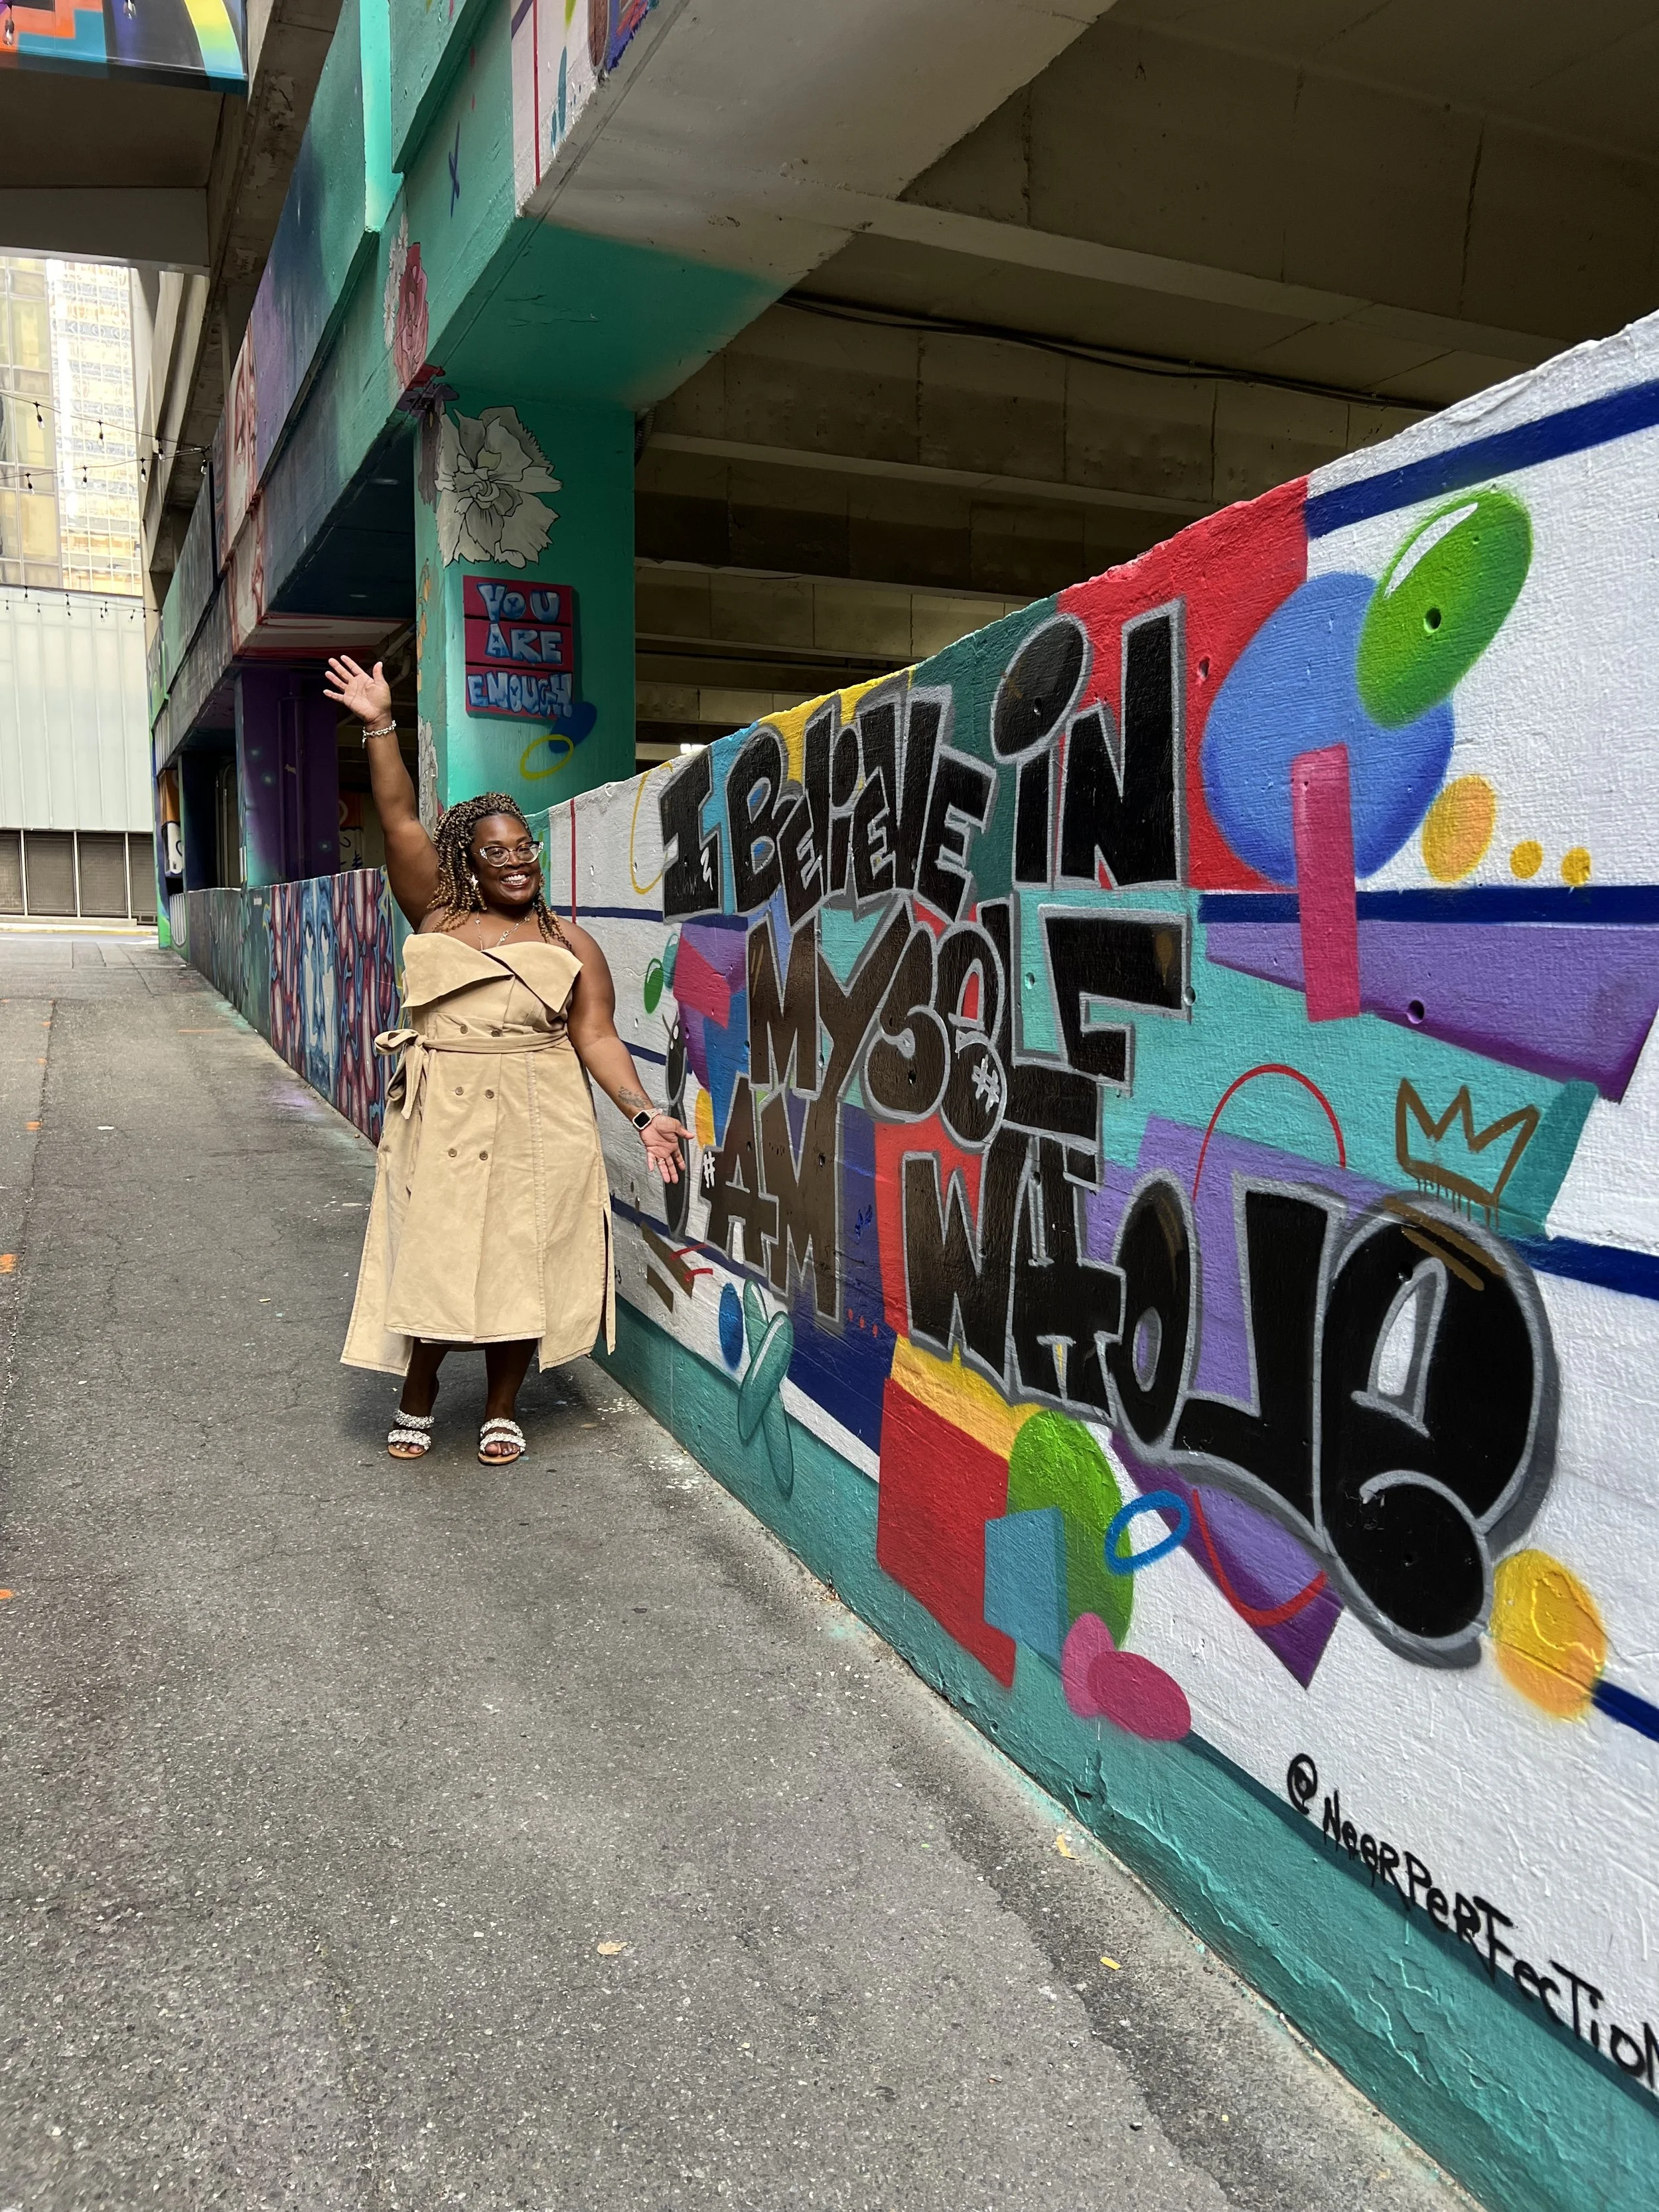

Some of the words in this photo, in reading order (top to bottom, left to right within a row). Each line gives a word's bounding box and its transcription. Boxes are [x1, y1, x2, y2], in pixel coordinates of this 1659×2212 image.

[467, 671, 573, 718] ENOUGH
[485, 623, 563, 665] ARE
[658, 747, 724, 924] I
[700, 1071, 843, 1326] AM
